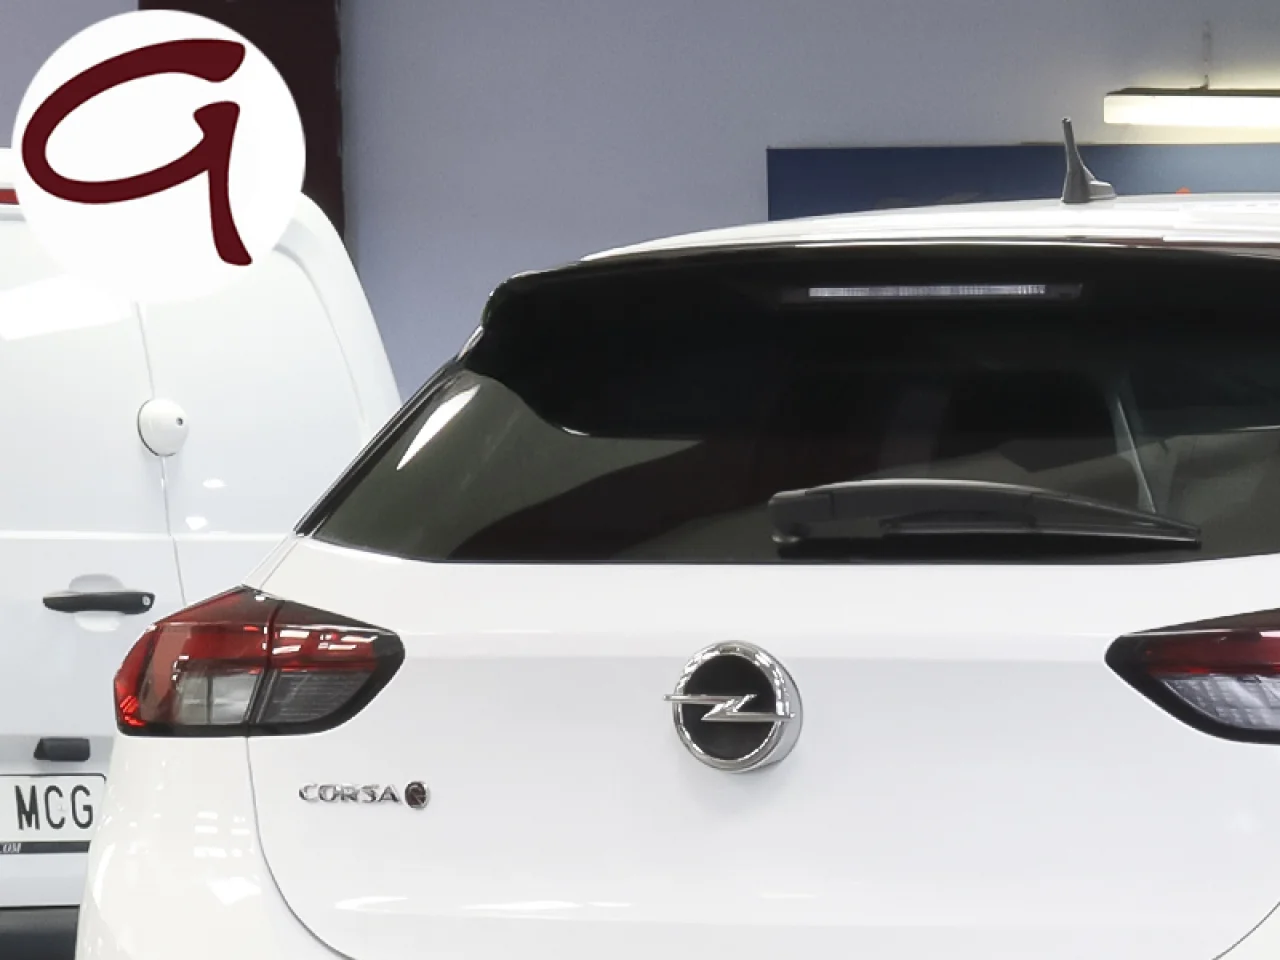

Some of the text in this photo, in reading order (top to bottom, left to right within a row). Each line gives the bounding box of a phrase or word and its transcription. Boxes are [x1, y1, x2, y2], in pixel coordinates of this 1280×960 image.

[299, 783, 402, 804] CORSA
[14, 784, 94, 831] MCG
[0, 842, 22, 854] OM
